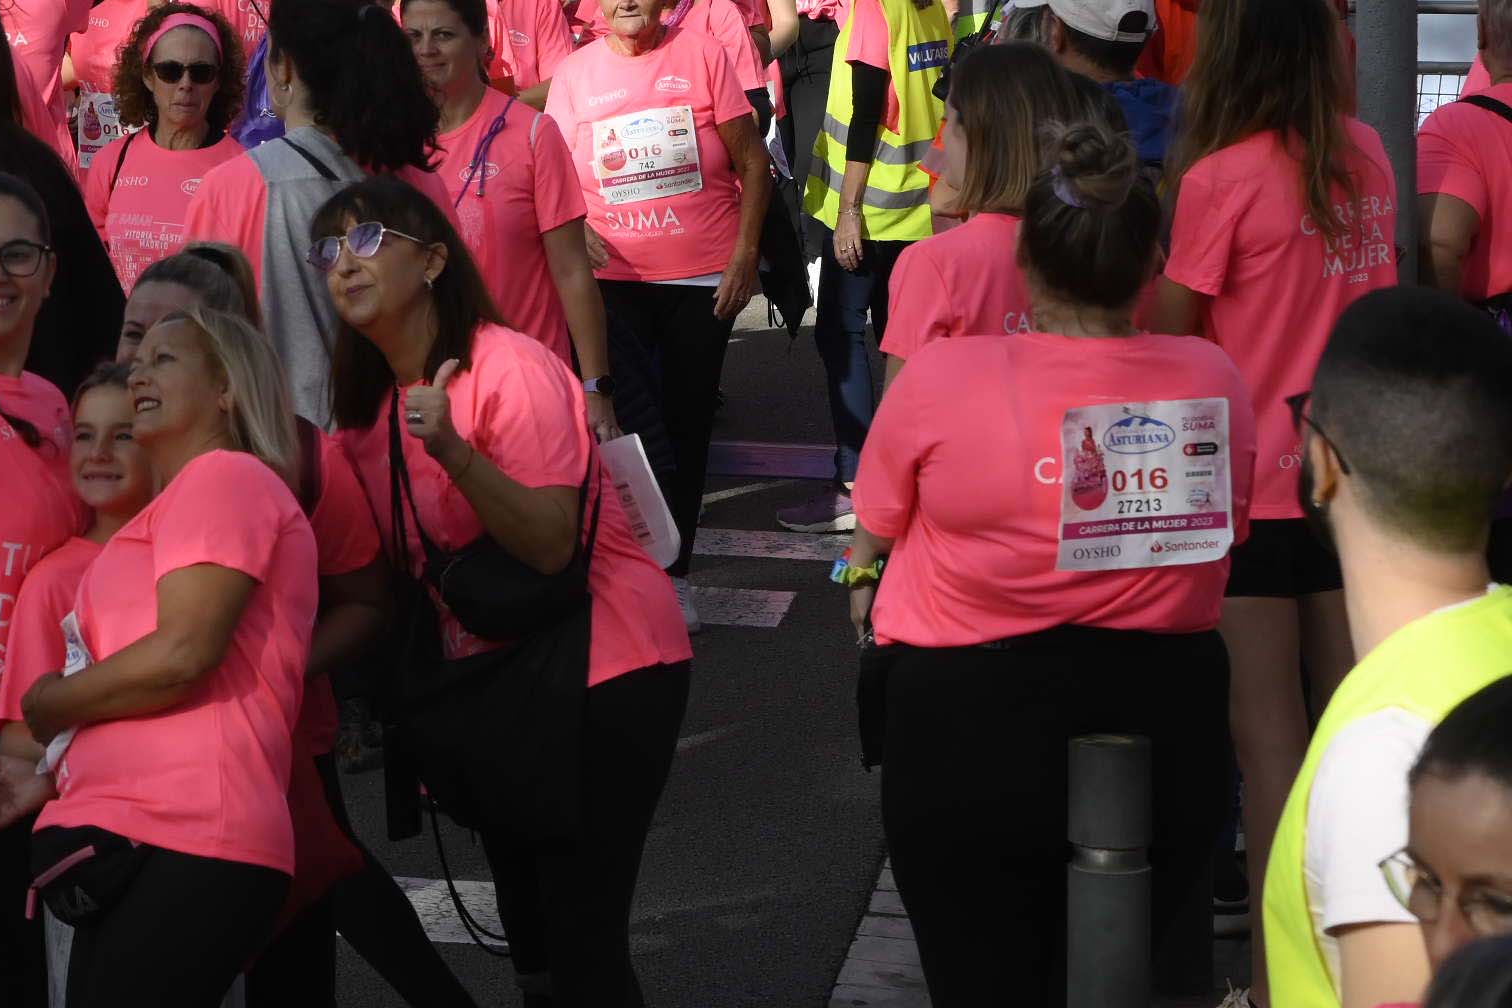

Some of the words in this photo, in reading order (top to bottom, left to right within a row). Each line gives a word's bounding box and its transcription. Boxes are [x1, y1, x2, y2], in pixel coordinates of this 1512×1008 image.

[629, 143, 662, 160] 016
[639, 160, 656, 171] 742
[611, 175, 637, 185] CARRERA
[663, 178, 694, 189] Santander
[603, 206, 680, 231] SUMA
[1361, 220, 1384, 245] LA
[1322, 243, 1392, 279] MUJER
[1349, 273, 1369, 284] 2023
[1182, 422, 1216, 432] SUMA
[1108, 433, 1170, 447] ASTURIANA
[1112, 467, 1169, 491] 016
[1117, 498, 1163, 515] 27213
[1079, 522, 1120, 536] CARRERA
[1121, 521, 1134, 533] DE
[1135, 520, 1150, 532] LA
[1152, 518, 1188, 531] MUJER
[1190, 517, 1214, 527] 2023
[1072, 545, 1122, 561] OYSHO
[1164, 538, 1220, 553] Santander
